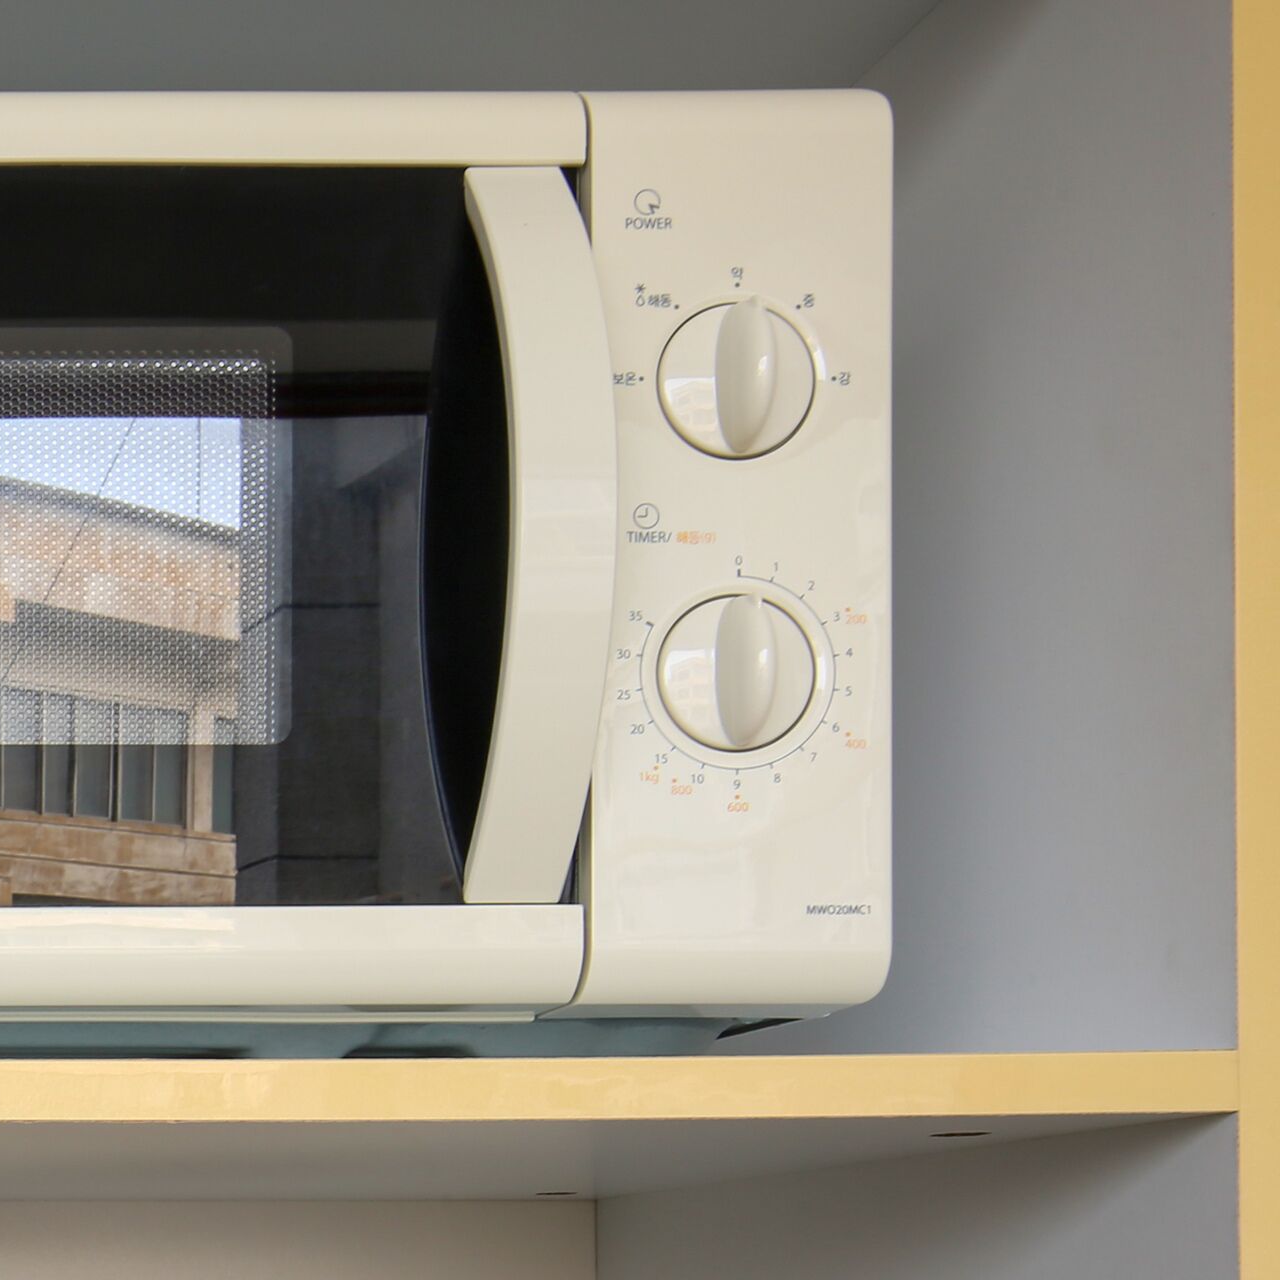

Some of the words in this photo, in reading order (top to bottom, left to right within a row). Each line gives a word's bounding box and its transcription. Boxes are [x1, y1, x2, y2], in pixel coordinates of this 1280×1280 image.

[624, 217, 673, 230] POWER
[730, 266, 744, 280] 약
[647, 293, 673, 308] 해동
[802, 293, 815, 309] 중
[612, 371, 637, 386] 보온
[839, 370, 852, 387] 강
[735, 555, 743, 566] 0
[772, 561, 779, 572] 1
[807, 581, 816, 591] 2
[629, 610, 643, 622] 35
[833, 611, 841, 622] 3
[845, 613, 867, 625] 200
[616, 649, 631, 660] 30
[845, 648, 854, 658] 4
[616, 690, 631, 701] 25
[845, 686, 853, 696] 5
[630, 724, 645, 735] 20
[832, 722, 840, 733] 6
[844, 738, 867, 749] 400
[655, 753, 668, 765] 15
[810, 752, 818, 763] 7
[639, 771, 660, 785] 1kg
[690, 773, 705, 785] 10
[773, 773, 781, 784] 8
[670, 784, 693, 796] 800
[733, 779, 741, 790] 9
[727, 801, 750, 813] 600
